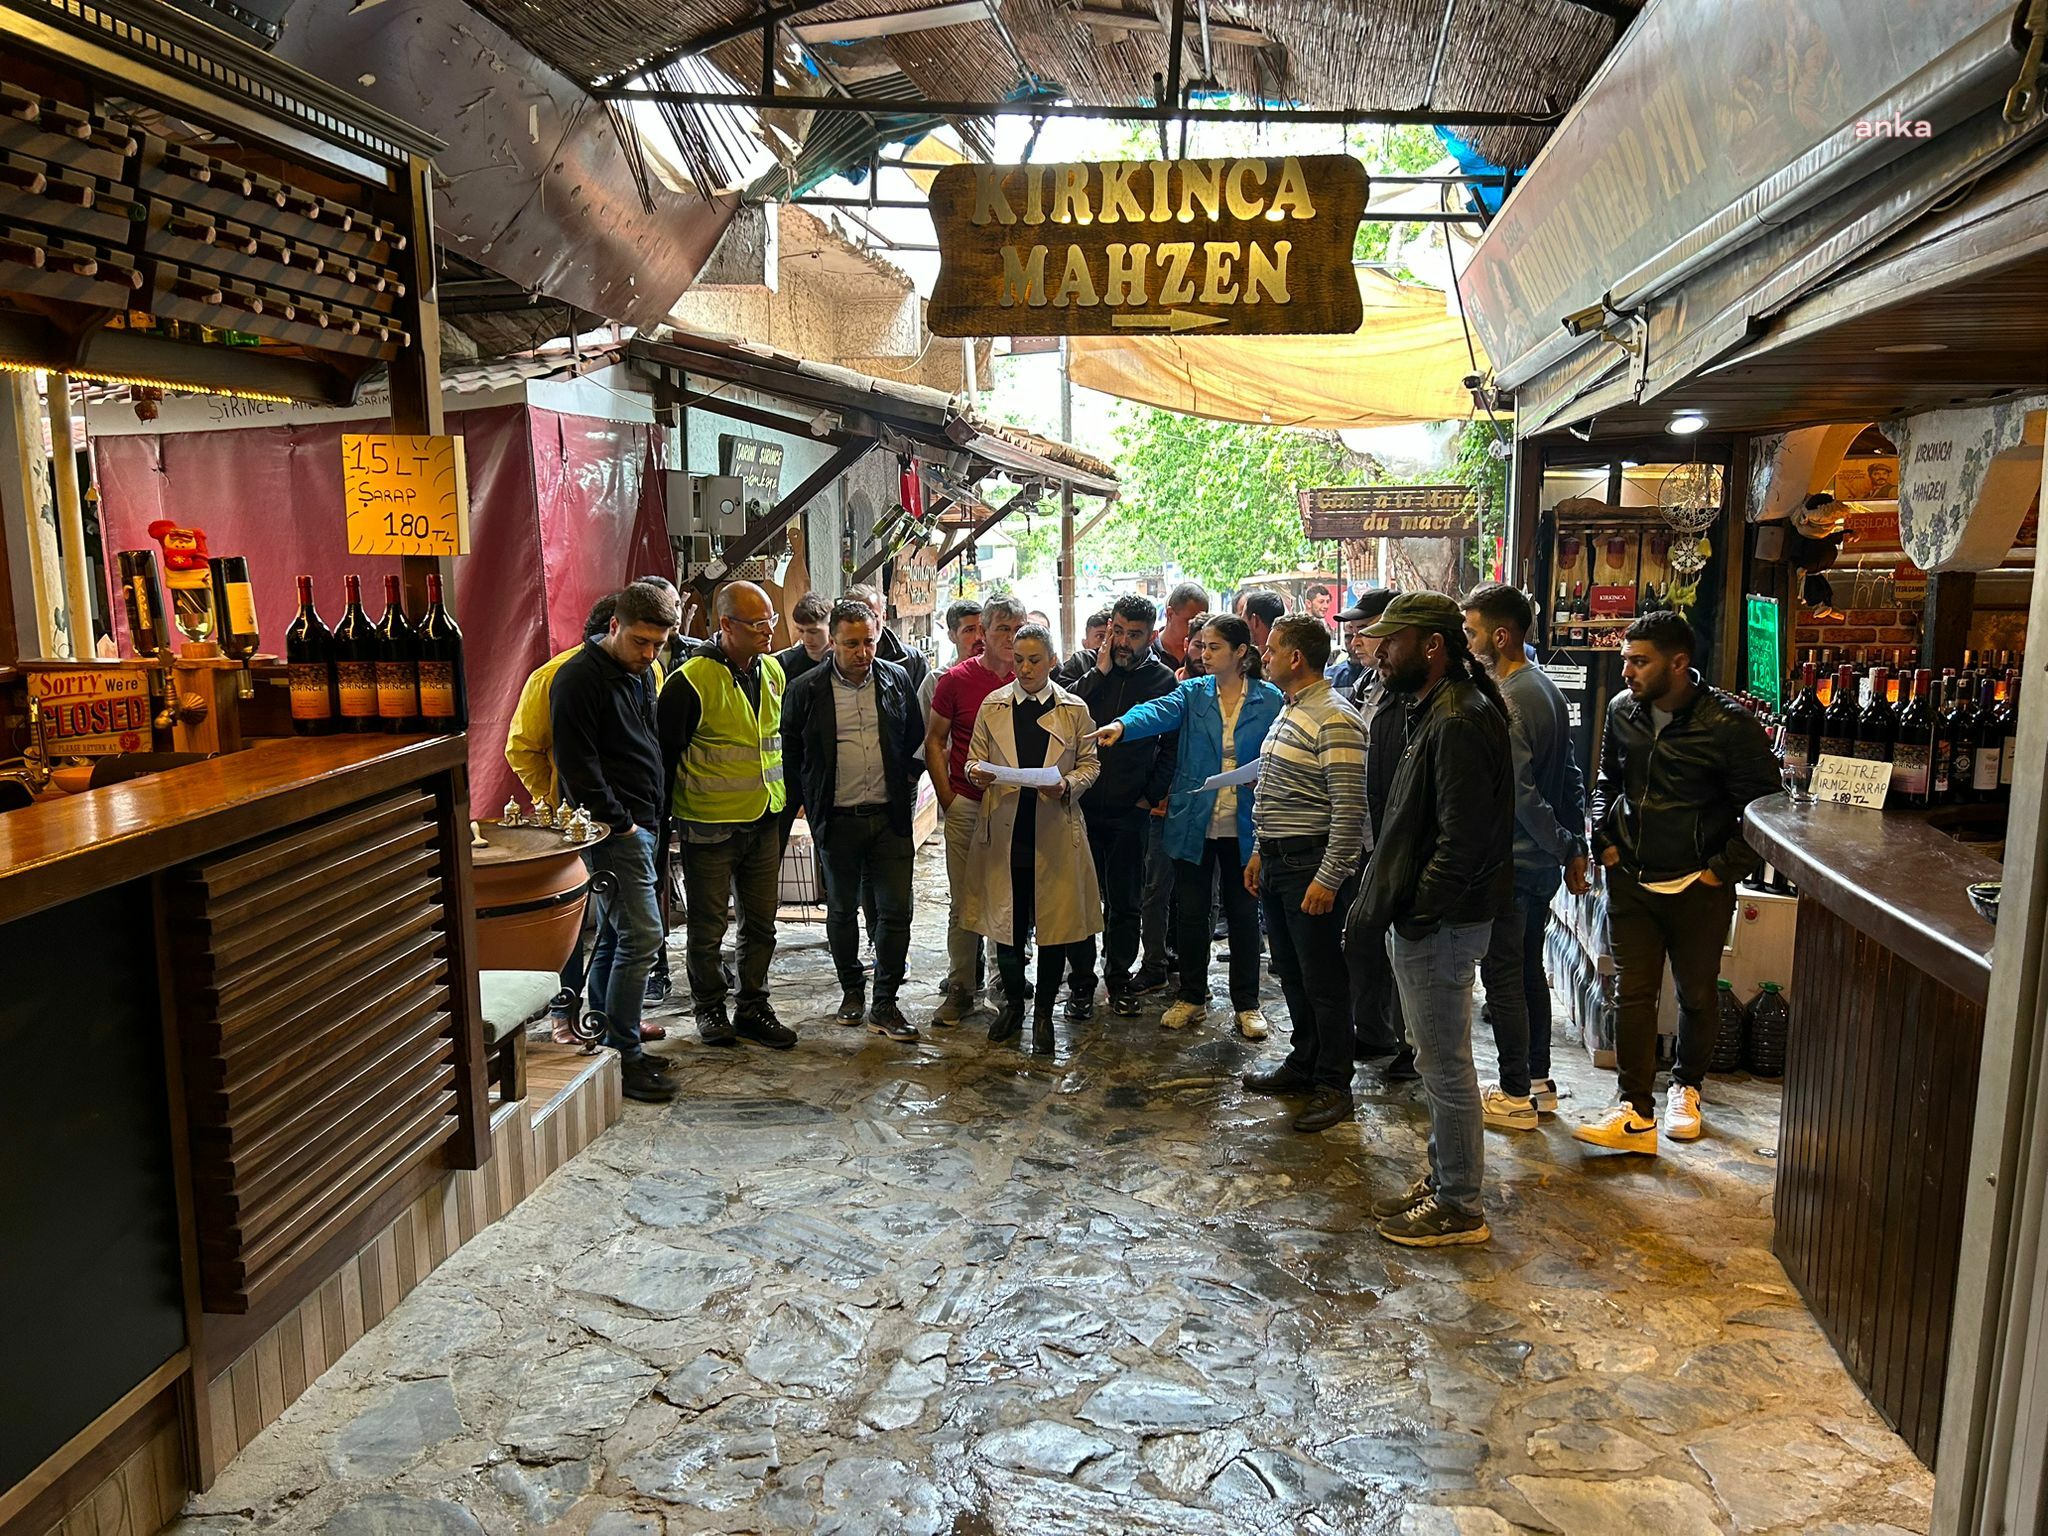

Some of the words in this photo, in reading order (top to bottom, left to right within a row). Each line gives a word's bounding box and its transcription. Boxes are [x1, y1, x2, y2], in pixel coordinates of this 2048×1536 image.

[971, 156, 1317, 226] KIRKINCA
[1000, 240, 1293, 307] MAHZEN
[396, 456, 430, 477] LT
[383, 511, 429, 539] 180
[431, 530, 455, 542] TL
[40, 672, 103, 698] Sorry
[105, 678, 139, 692] We're
[43, 695, 146, 740] CLOSED
[1852, 795, 1870, 804] TL
